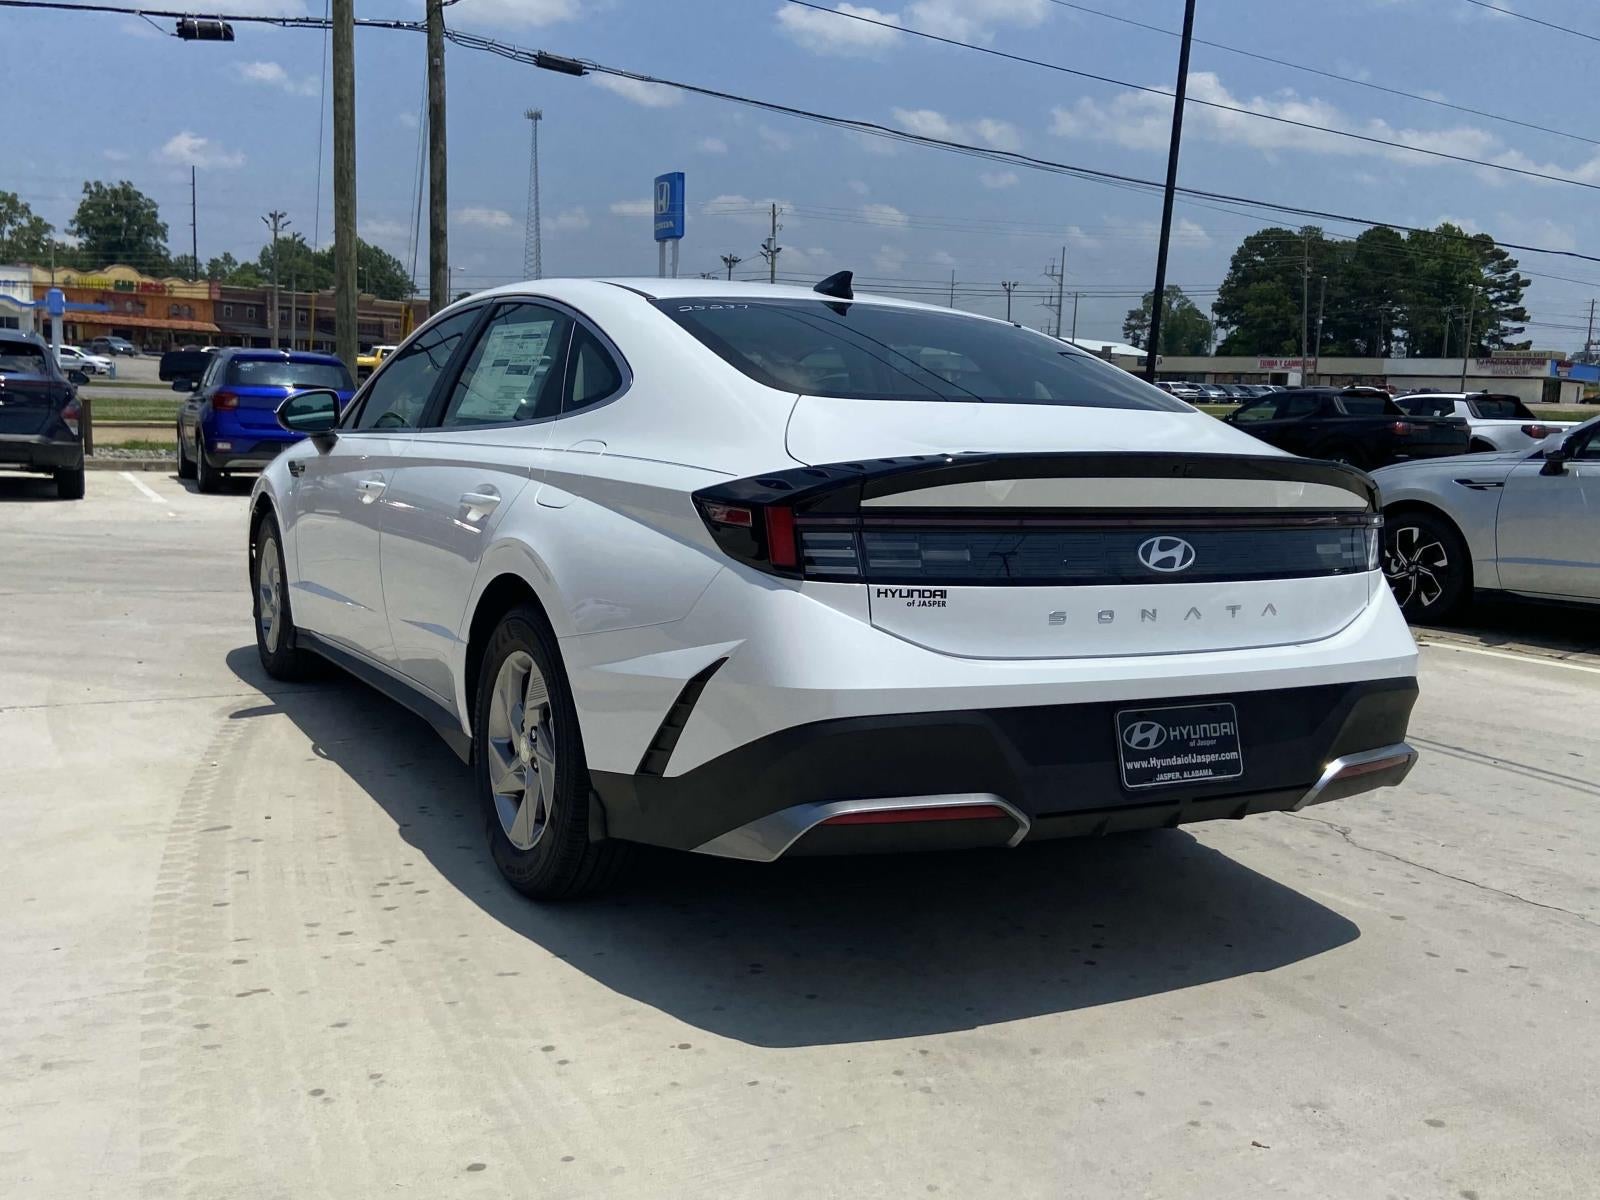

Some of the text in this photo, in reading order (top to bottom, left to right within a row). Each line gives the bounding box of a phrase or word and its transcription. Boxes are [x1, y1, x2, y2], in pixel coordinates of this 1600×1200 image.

[876, 588, 948, 599] HYUNDAI
[906, 599, 947, 608] of JASPER
[1049, 602, 1278, 626] SONATA
[1169, 722, 1235, 740] HYUNDAI
[1197, 739, 1217, 747] Jasper
[1126, 751, 1239, 770] www.HyundaiofJasper.com
[1156, 769, 1213, 782] JASPER, ALABAMA
